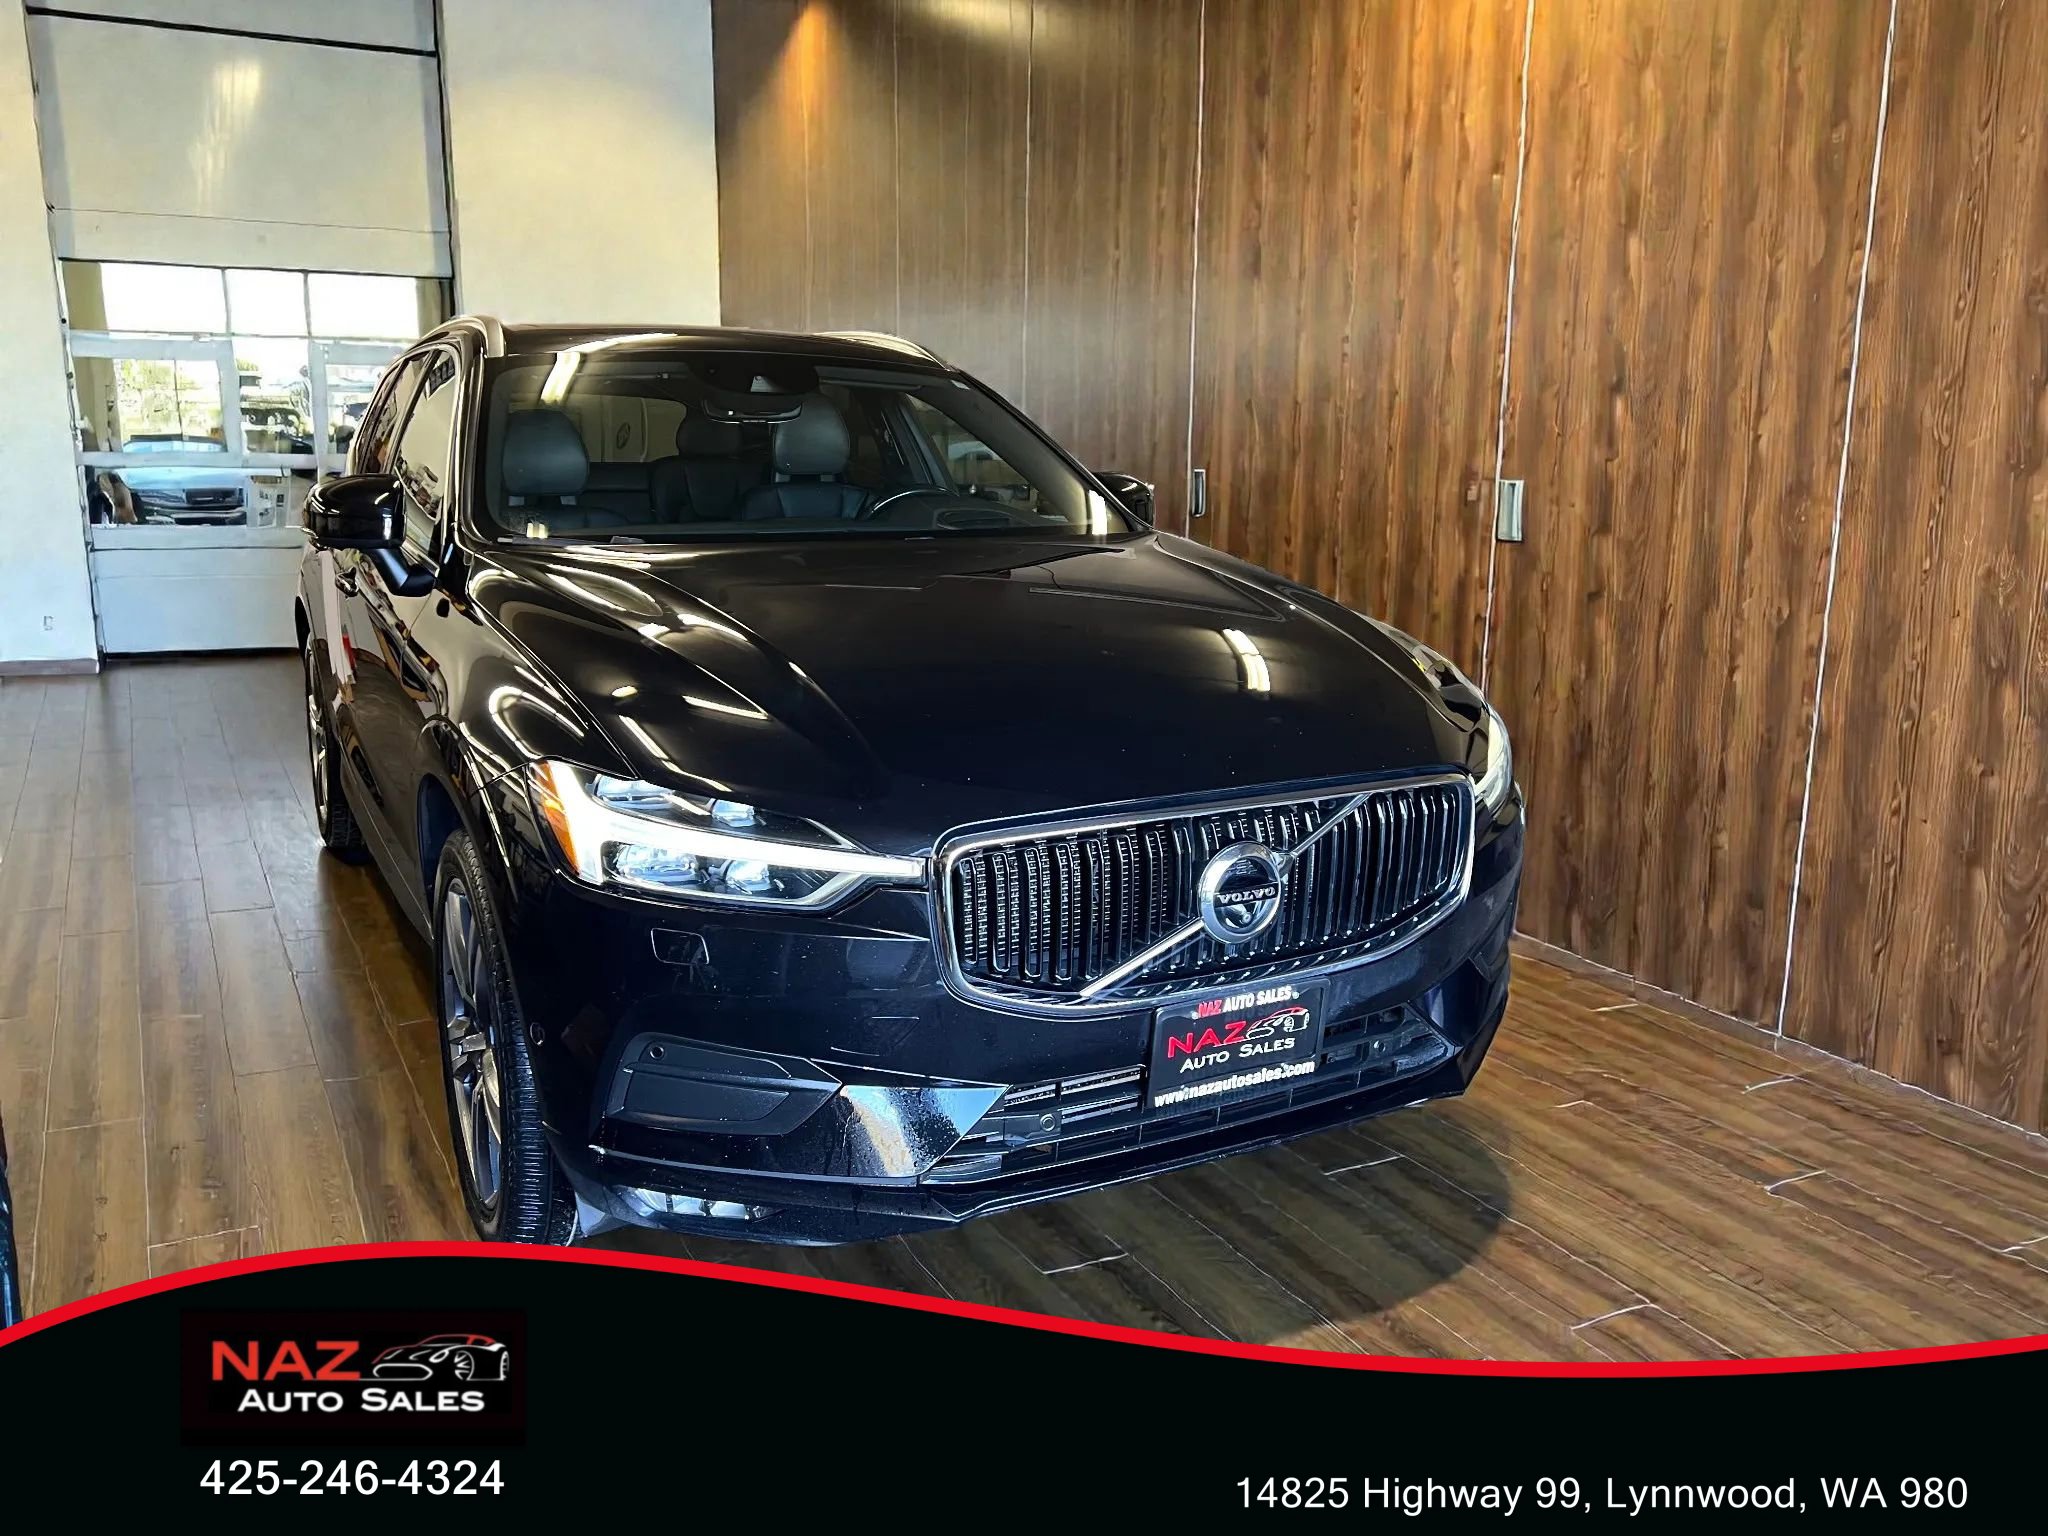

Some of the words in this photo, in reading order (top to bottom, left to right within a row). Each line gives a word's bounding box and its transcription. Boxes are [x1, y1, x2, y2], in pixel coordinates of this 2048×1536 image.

[1217, 886, 1276, 904] VOLVO
[1198, 1000, 1223, 1018] NAZ
[1223, 993, 1255, 1013] AUTO
[1256, 986, 1293, 1005] SALES
[1167, 1020, 1247, 1059] NAZ
[1179, 1050, 1230, 1074] AUTO
[1239, 1037, 1296, 1058] SALES
[1154, 1060, 1316, 1108] www.nazautosales.com
